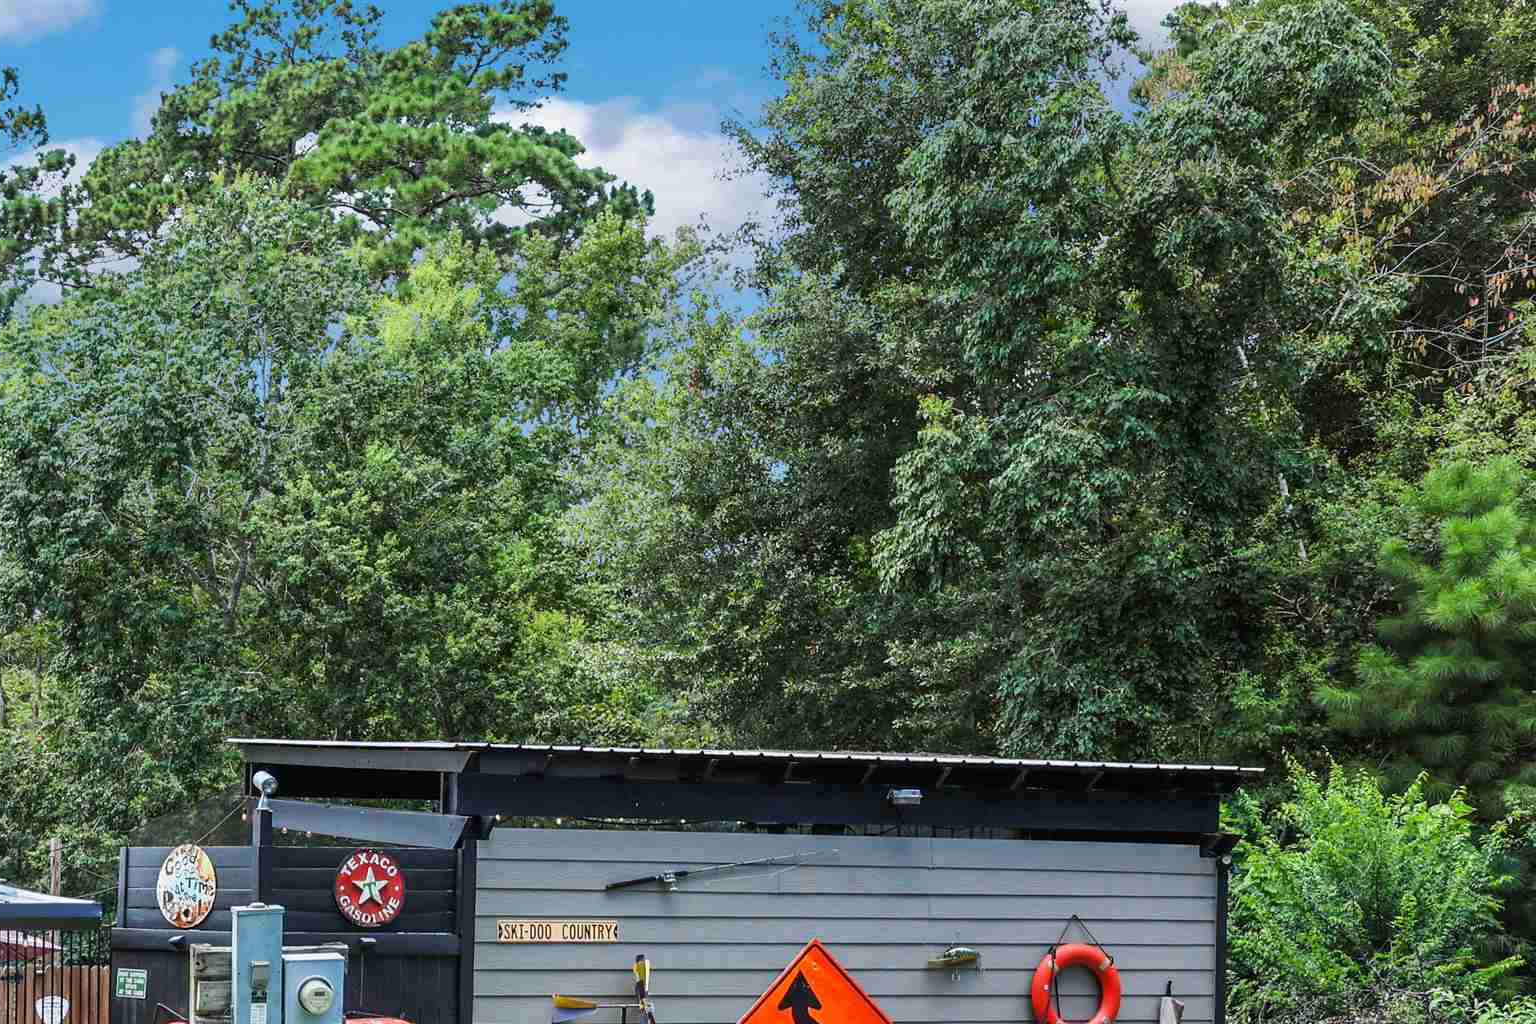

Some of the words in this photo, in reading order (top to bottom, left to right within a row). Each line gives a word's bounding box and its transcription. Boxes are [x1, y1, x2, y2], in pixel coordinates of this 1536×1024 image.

[340, 852, 398, 877] TEXACO
[363, 881, 377, 899] T
[339, 895, 400, 924] GASOLINE
[503, 923, 552, 940] SKI-DOO
[562, 923, 614, 940] COUNTRY
